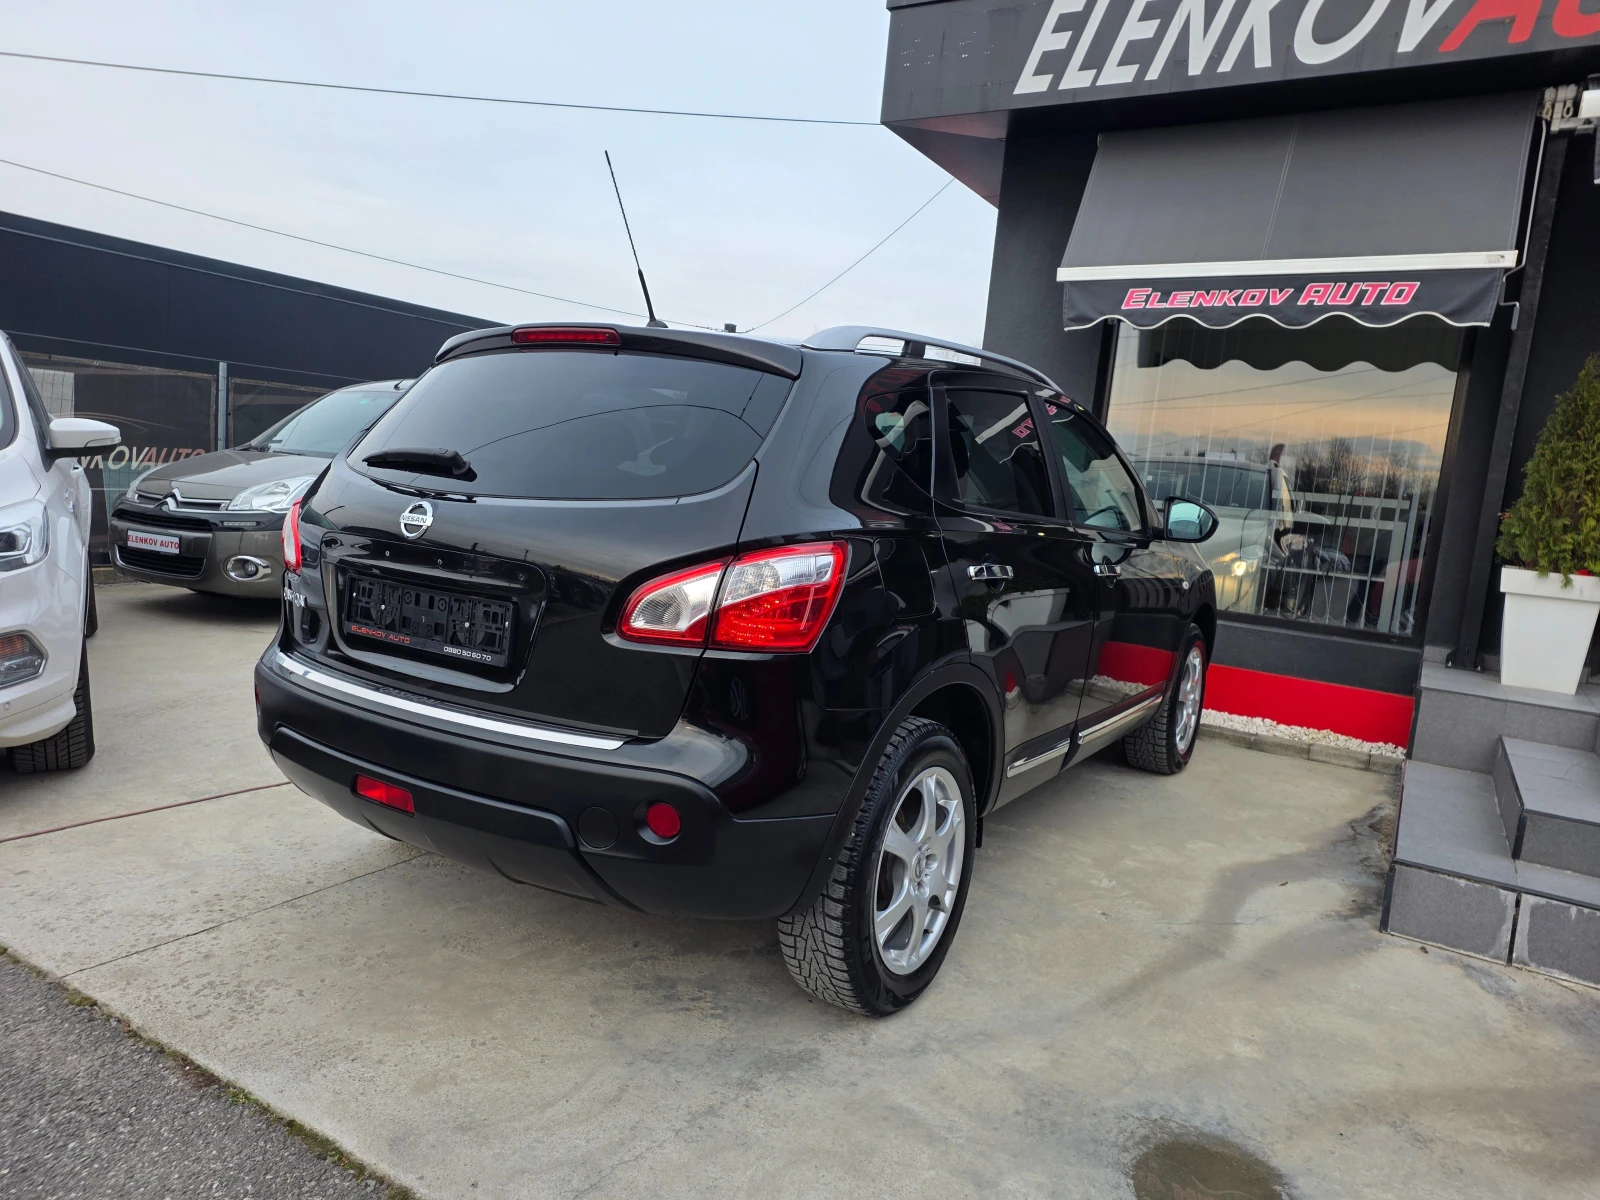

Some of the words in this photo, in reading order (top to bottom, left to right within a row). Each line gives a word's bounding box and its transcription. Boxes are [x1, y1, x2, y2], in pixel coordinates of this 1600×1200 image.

[1121, 288, 1294, 309] ELENKOV
[1297, 282, 1420, 305] AUTO
[401, 514, 427, 523] NISSAN
[127, 535, 157, 546] ELENKOV
[160, 540, 180, 549] AUTO
[351, 625, 387, 638] ELENKOV
[388, 634, 411, 644] AUTO
